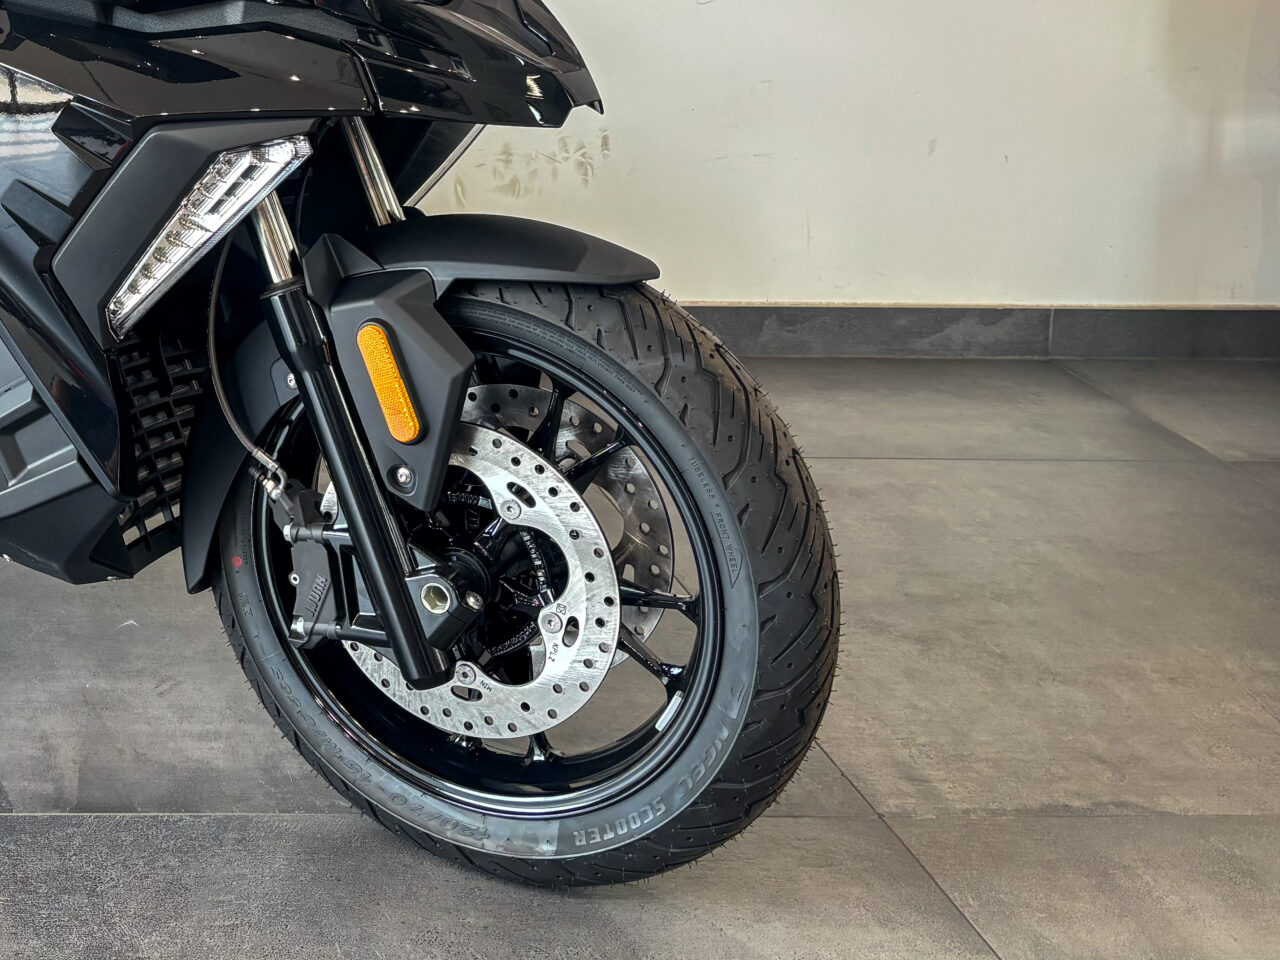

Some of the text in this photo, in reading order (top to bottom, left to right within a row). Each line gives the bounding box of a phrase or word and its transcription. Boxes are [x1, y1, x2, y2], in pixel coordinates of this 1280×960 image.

[688, 456, 716, 499] TUBELESS
[714, 512, 739, 574] FRONT WHEEL
[480, 680, 494, 692] MIN
[390, 793, 491, 840] 120/70
[573, 796, 666, 846] SCOOTER
